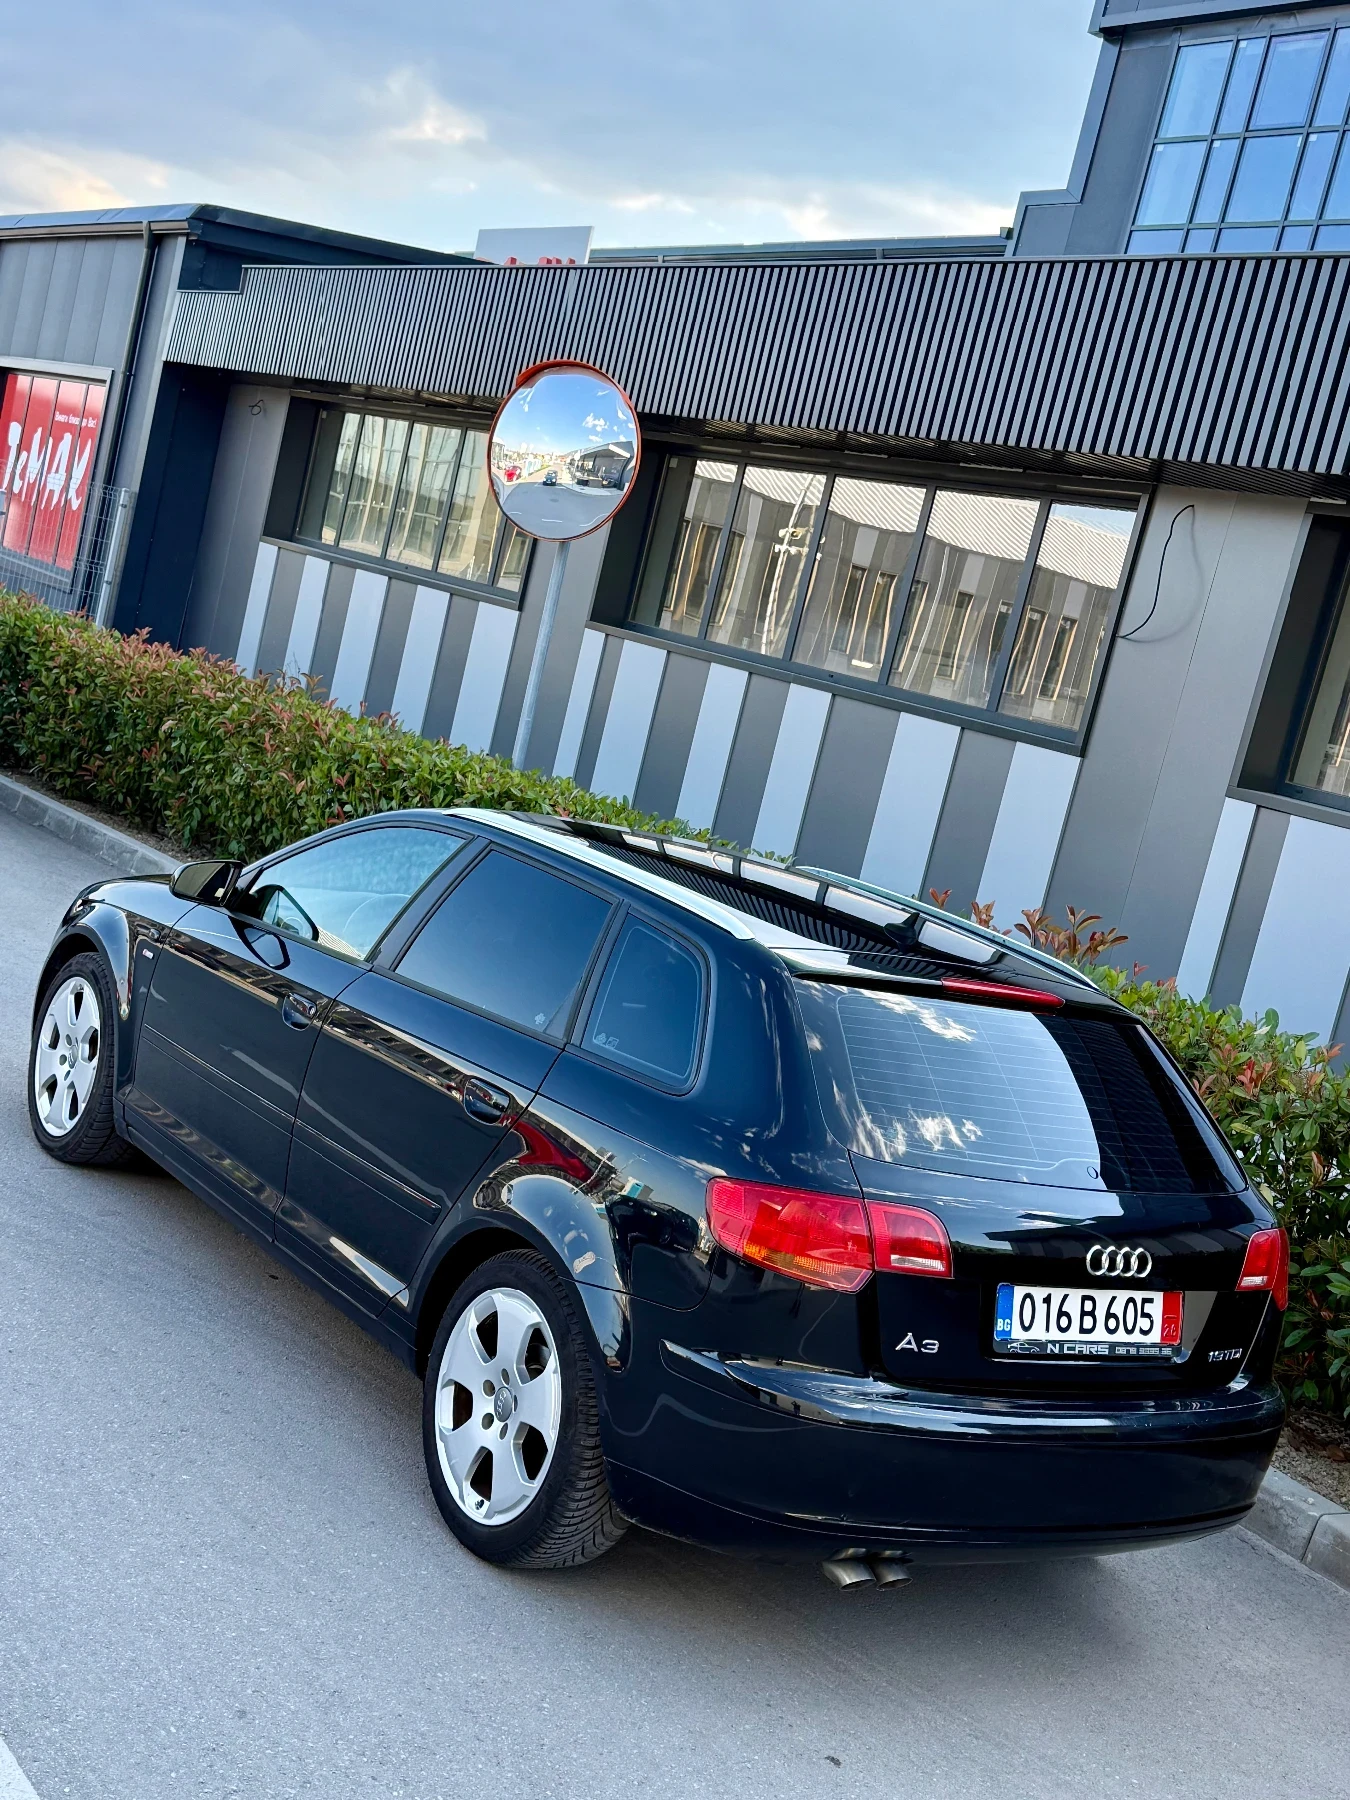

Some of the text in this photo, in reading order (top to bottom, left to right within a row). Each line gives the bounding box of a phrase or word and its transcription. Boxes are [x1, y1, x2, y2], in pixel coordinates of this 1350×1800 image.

[996, 1318, 1012, 1331] BG
[895, 1332, 940, 1353] A3
[1063, 1344, 1110, 1355] CARS
